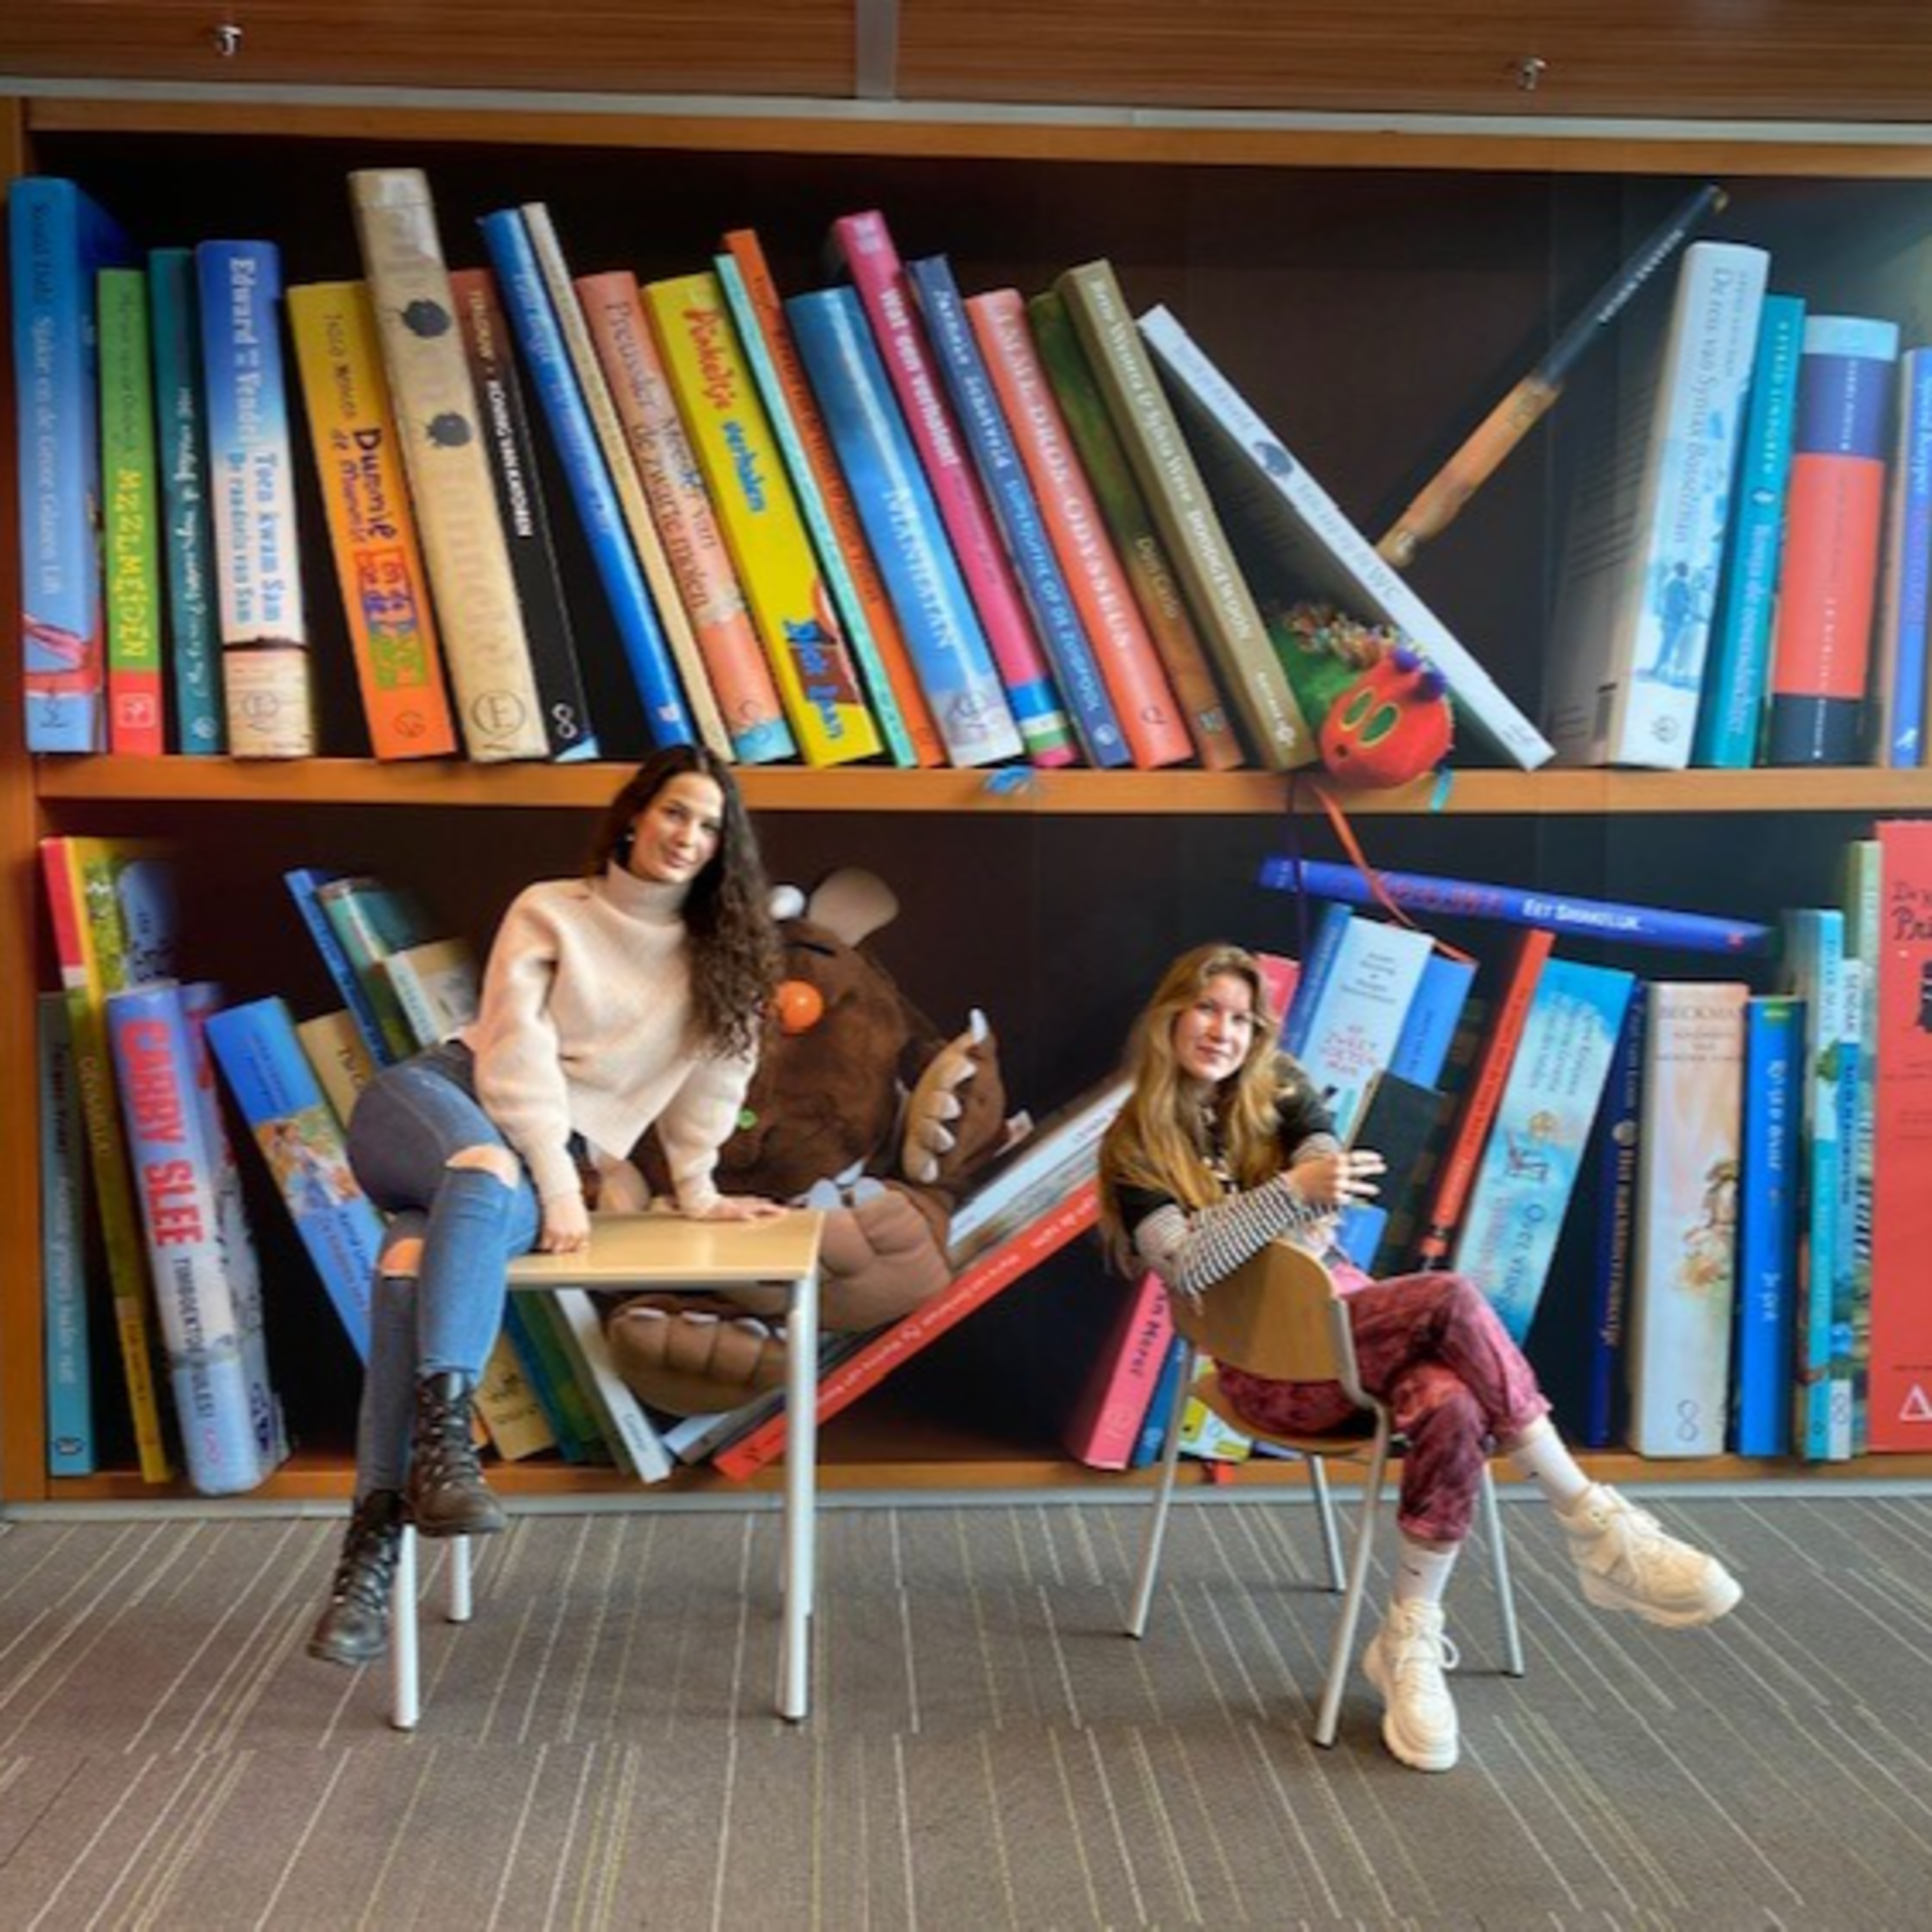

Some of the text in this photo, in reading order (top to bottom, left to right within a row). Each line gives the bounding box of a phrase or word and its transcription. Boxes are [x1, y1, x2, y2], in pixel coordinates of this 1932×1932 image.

[227, 257, 261, 345] Edward
[1708, 266, 1735, 298] De
[602, 296, 665, 413] Preussler
[876, 287, 961, 470] Wat een verhalen!
[1698, 337, 1719, 371] van
[35, 377, 50, 402] en
[37, 406, 57, 427] de
[234, 371, 267, 444] Vendel
[675, 299, 775, 514] Pinkeltje verhalen
[1683, 372, 1719, 439] Syntax
[225, 451, 247, 472] De
[347, 426, 403, 542] Dummie
[37, 493, 62, 561] Glazen
[253, 453, 287, 621] Toen kwam Sam
[630, 419, 714, 611] de zwarte molen
[691, 507, 719, 551] van
[1025, 402, 1073, 486] DROS
[1060, 494, 1132, 650] ODYSSEUS
[41, 565, 64, 594] Lift
[232, 554, 252, 583] van
[234, 587, 256, 623] Sam
[117, 1015, 216, 1419] CARRY SLEE TIMBOEKTOE RULES!
